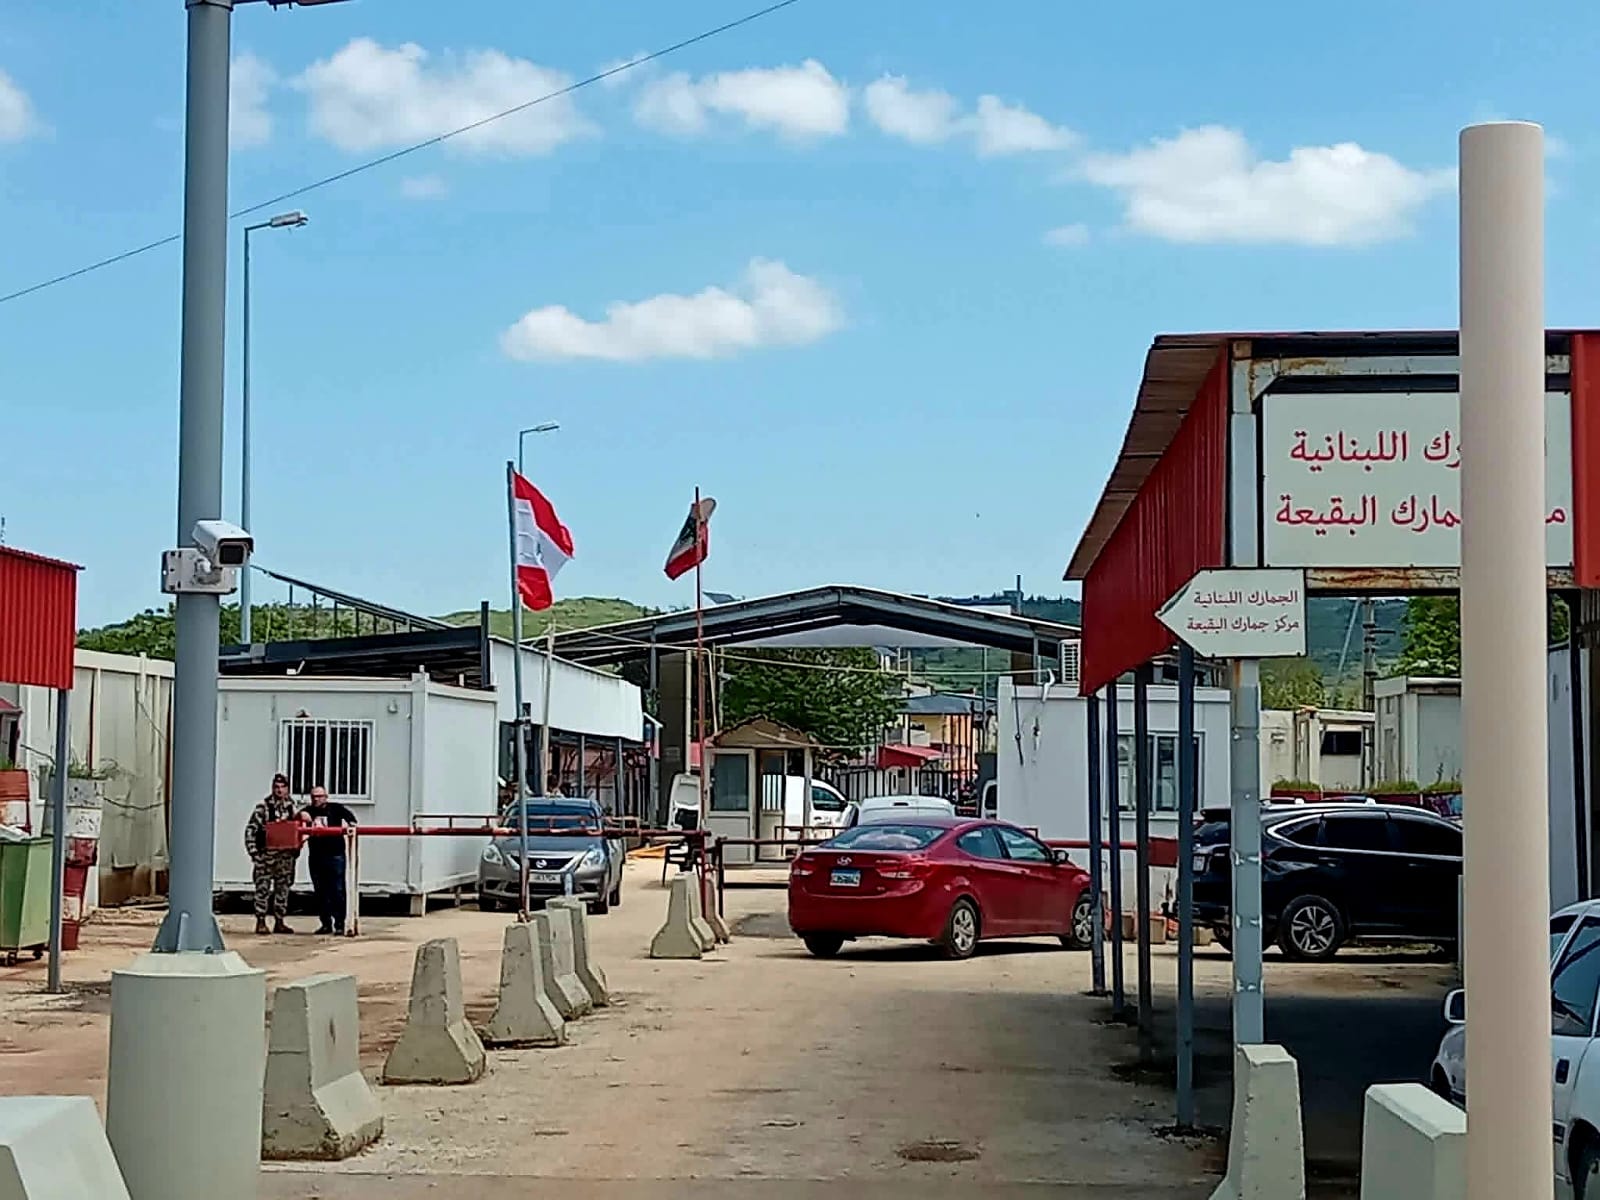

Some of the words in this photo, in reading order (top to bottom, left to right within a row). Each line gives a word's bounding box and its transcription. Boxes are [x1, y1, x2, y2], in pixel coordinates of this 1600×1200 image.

[1289, 430, 1409, 473] اللبنانية
[1274, 494, 1378, 536] البقيعة
[1390, 494, 1460, 533] مارك
[1193, 590, 1243, 609] اللبنانية
[1247, 589, 1299, 607] الجمارك
[1186, 616, 1228, 635] البقيعة
[1231, 615, 1270, 633] جمارك
[1274, 614, 1300, 633] مركز
